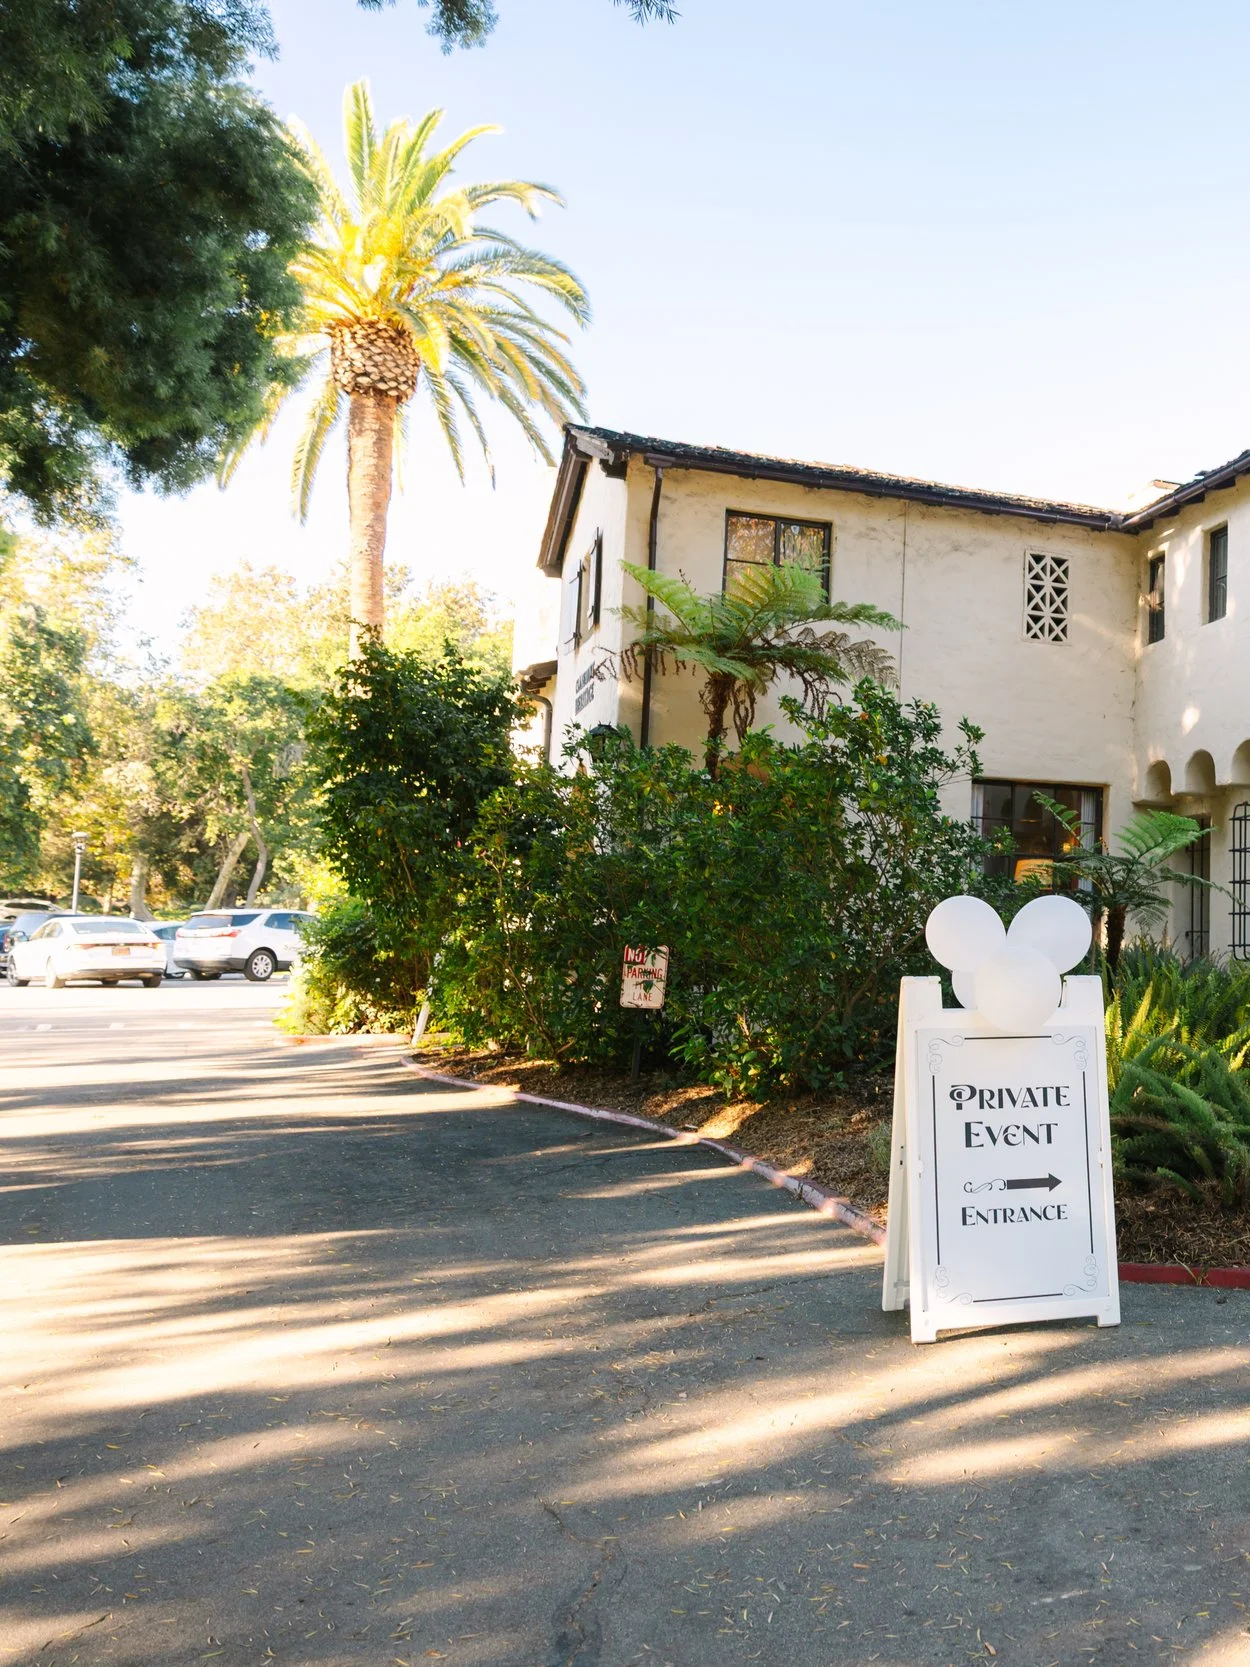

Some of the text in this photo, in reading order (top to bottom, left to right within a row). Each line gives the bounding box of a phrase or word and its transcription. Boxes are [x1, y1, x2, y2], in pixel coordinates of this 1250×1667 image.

[633, 992, 653, 1002] LANE
[949, 1084, 1071, 1111] PRIVATE
[964, 1121, 1059, 1148] EVENT
[961, 1204, 1068, 1226] ENTRANCE
